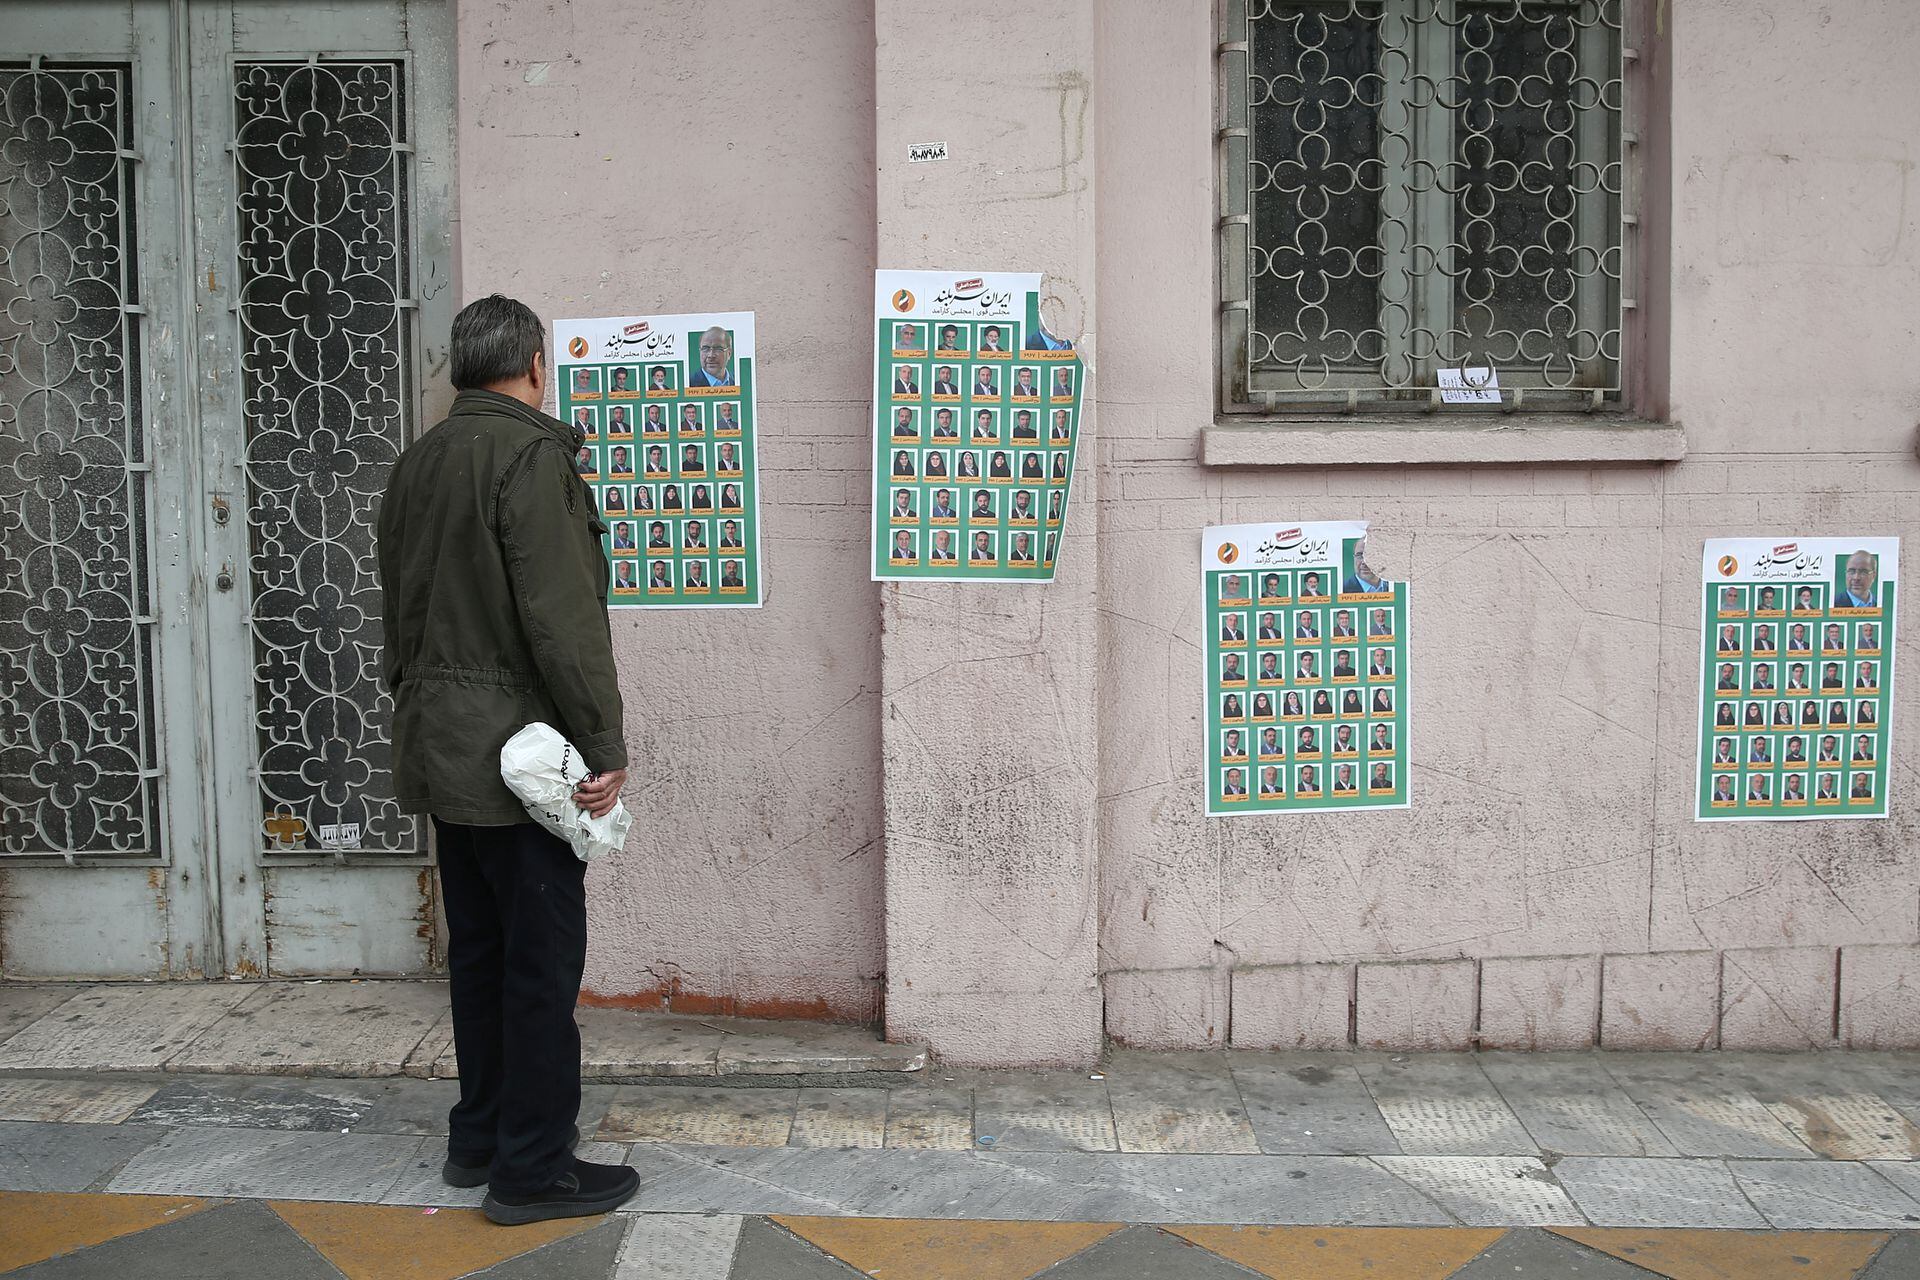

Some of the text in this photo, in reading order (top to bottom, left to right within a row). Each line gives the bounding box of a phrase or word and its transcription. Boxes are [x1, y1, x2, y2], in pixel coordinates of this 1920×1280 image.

[980, 292, 1012, 307] ایران
[932, 307, 949, 315] کارآمد
[977, 308, 988, 316] قوی
[647, 333, 675, 349] ایران
[1300, 539, 1328, 555] ایران
[1795, 555, 1823, 570] ایران
